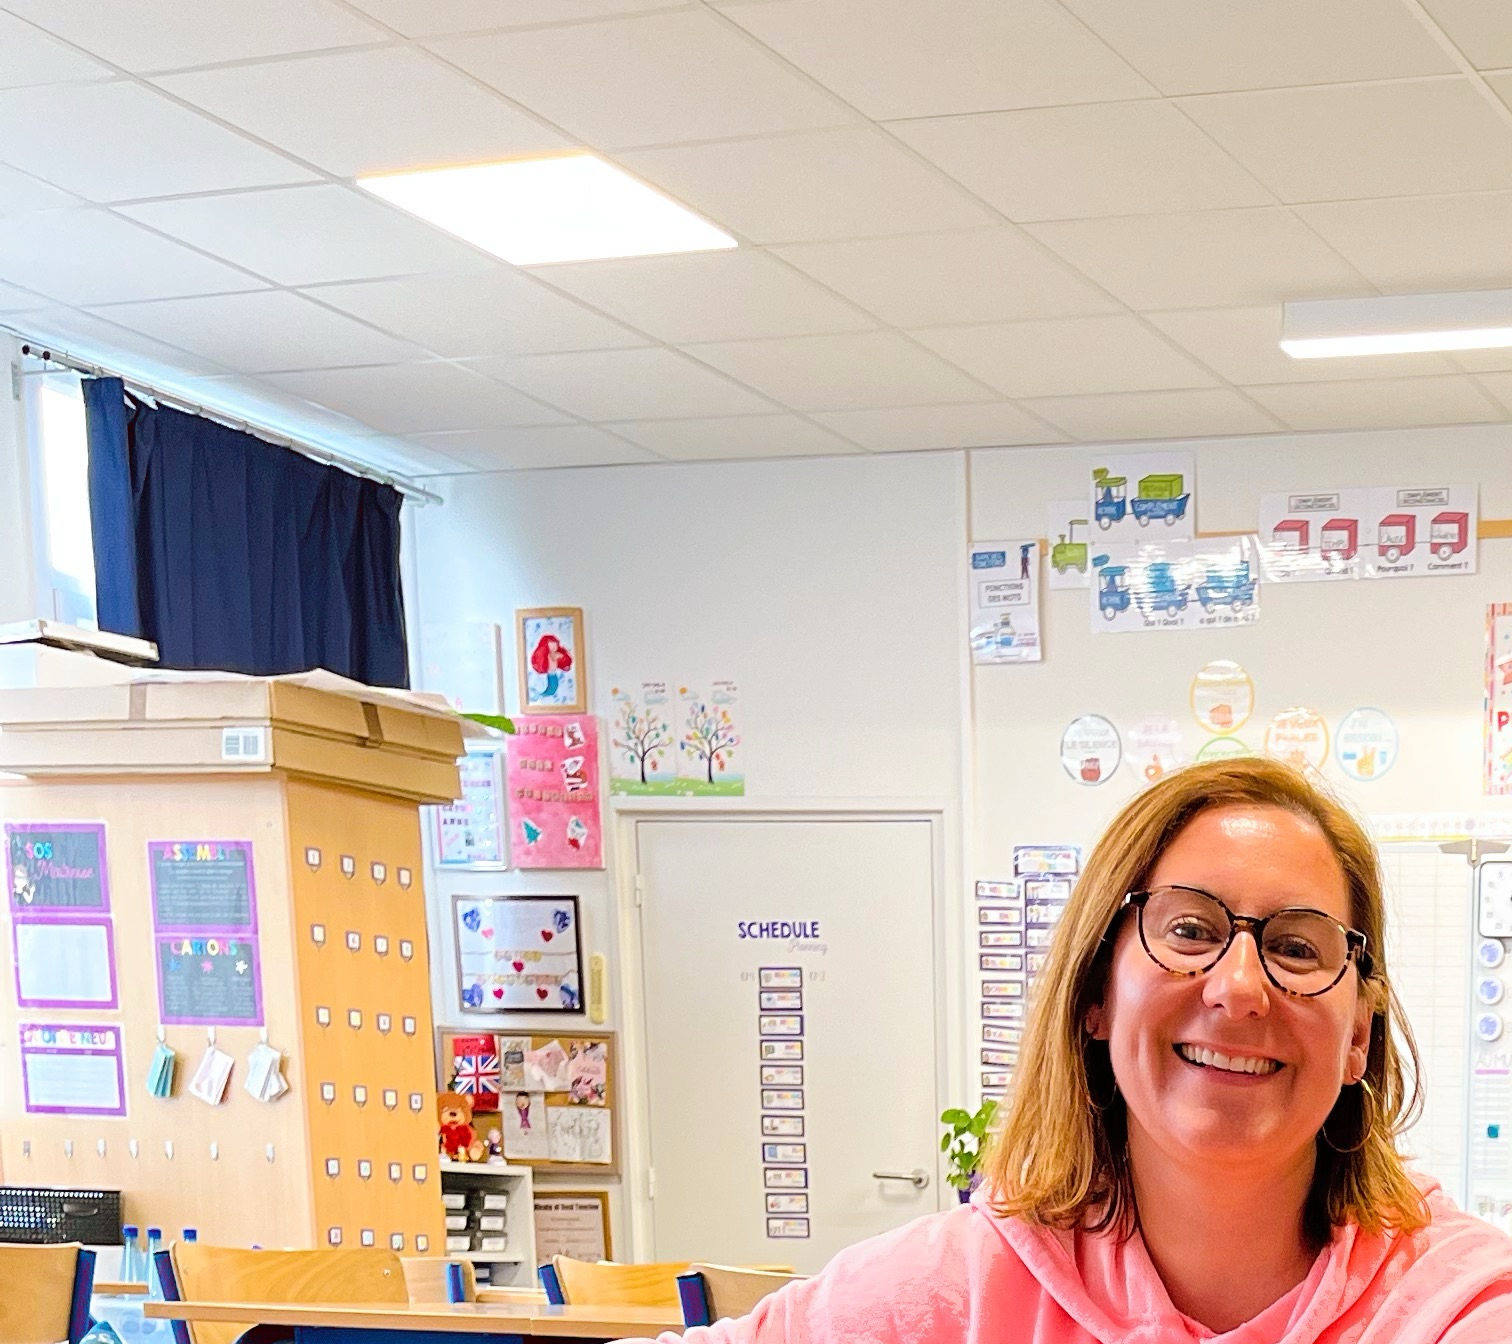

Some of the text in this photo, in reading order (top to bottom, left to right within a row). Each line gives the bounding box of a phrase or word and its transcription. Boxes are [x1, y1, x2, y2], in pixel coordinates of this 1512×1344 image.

[25, 841, 53, 860] SOS
[738, 921, 820, 939] SCHEDULE
[170, 938, 238, 956] CARTONS
